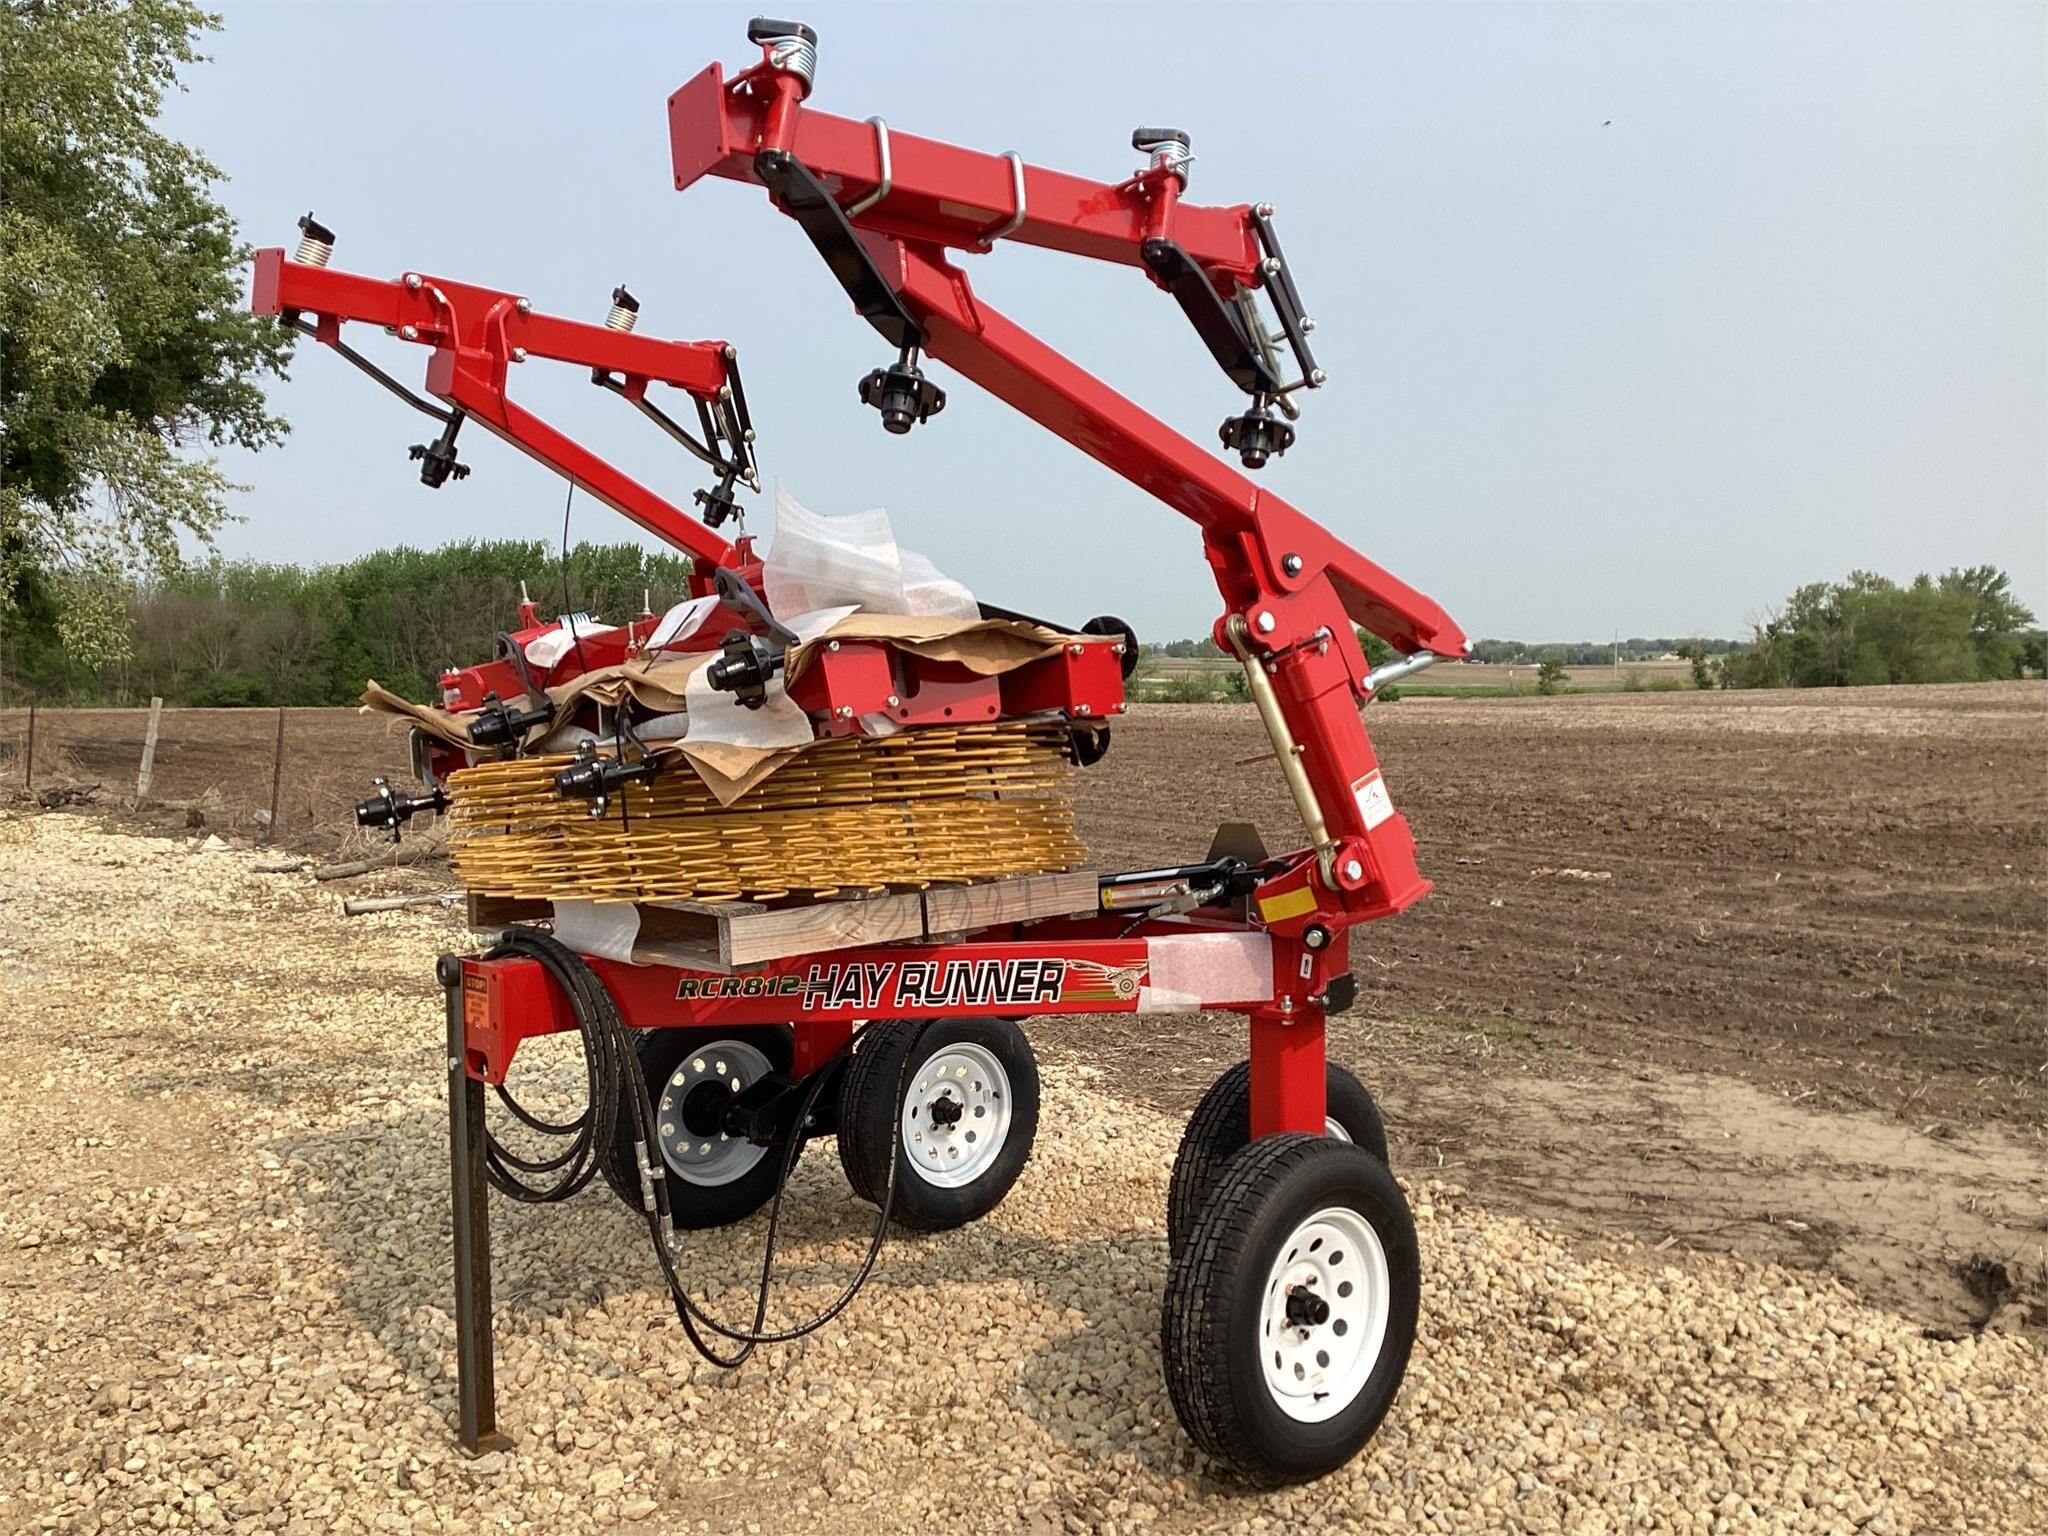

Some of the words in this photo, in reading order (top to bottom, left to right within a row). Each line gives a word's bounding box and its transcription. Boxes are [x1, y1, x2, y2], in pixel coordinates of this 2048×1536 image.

[676, 975, 802, 999] RCR812
[802, 962, 895, 1010] HAY
[894, 958, 1066, 1007] RUNNER
